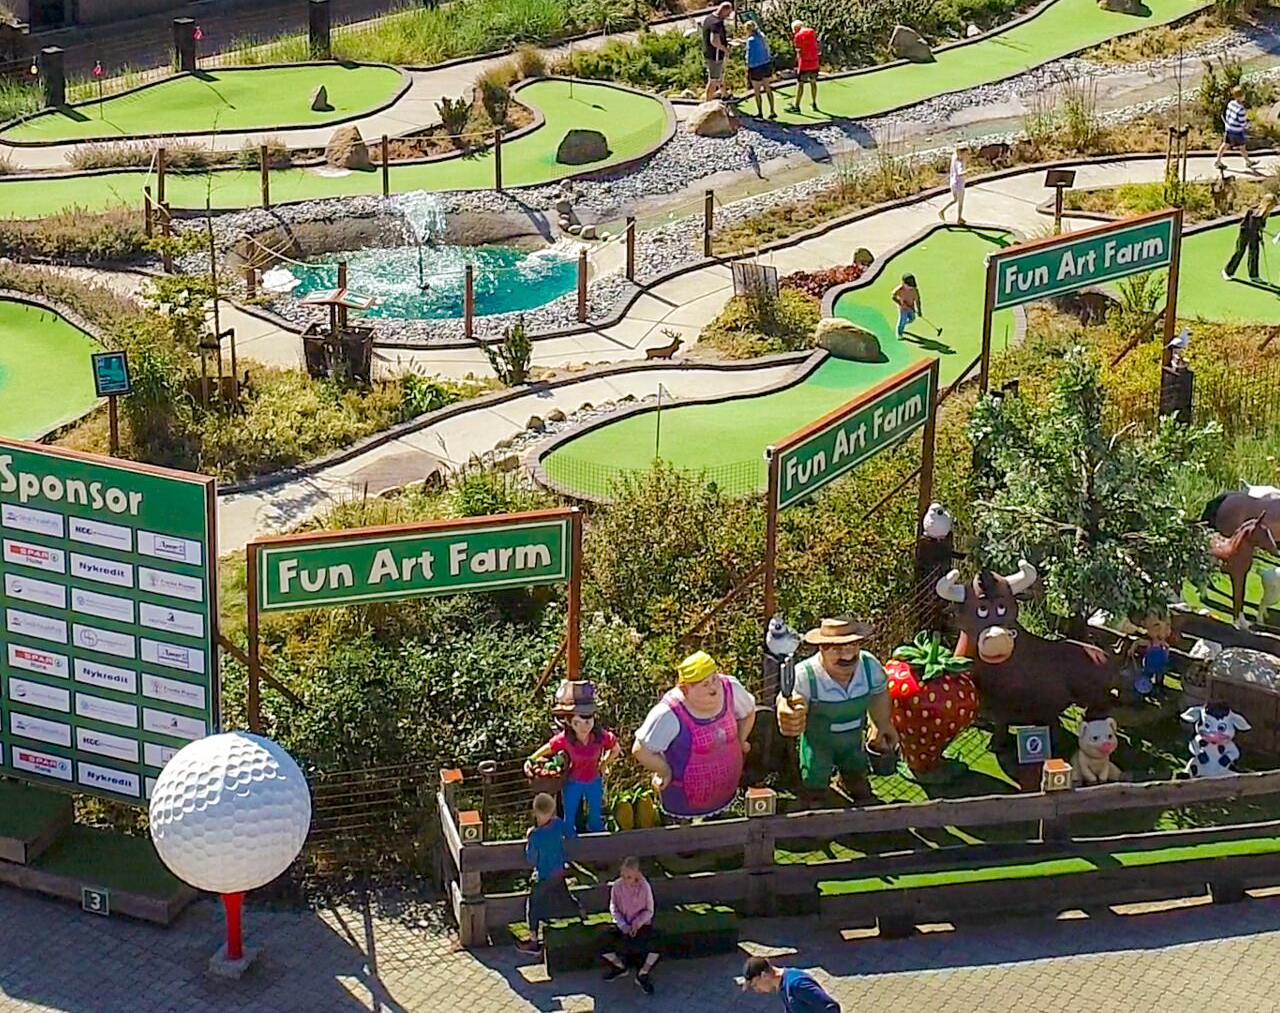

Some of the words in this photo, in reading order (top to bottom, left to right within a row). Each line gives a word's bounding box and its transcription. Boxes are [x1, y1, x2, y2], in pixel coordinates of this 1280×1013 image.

[1004, 263, 1048, 294] Fun
[1056, 250, 1096, 281] Art
[1104, 237, 1164, 268] Farm
[786, 450, 826, 492] Fun
[832, 422, 866, 464] Art
[873, 394, 922, 440] Farm
[20, 548, 49, 560] SPAR
[79, 561, 125, 578] Nykredit
[278, 558, 354, 594] Fun
[368, 548, 435, 584] Art
[449, 542, 552, 576] Farm
[24, 652, 52, 664] SPAR
[83, 668, 128, 684] Nykredit
[28, 754, 57, 768] SPAR
[87, 771, 132, 788] Nykredit
[90, 894, 101, 910] 3
